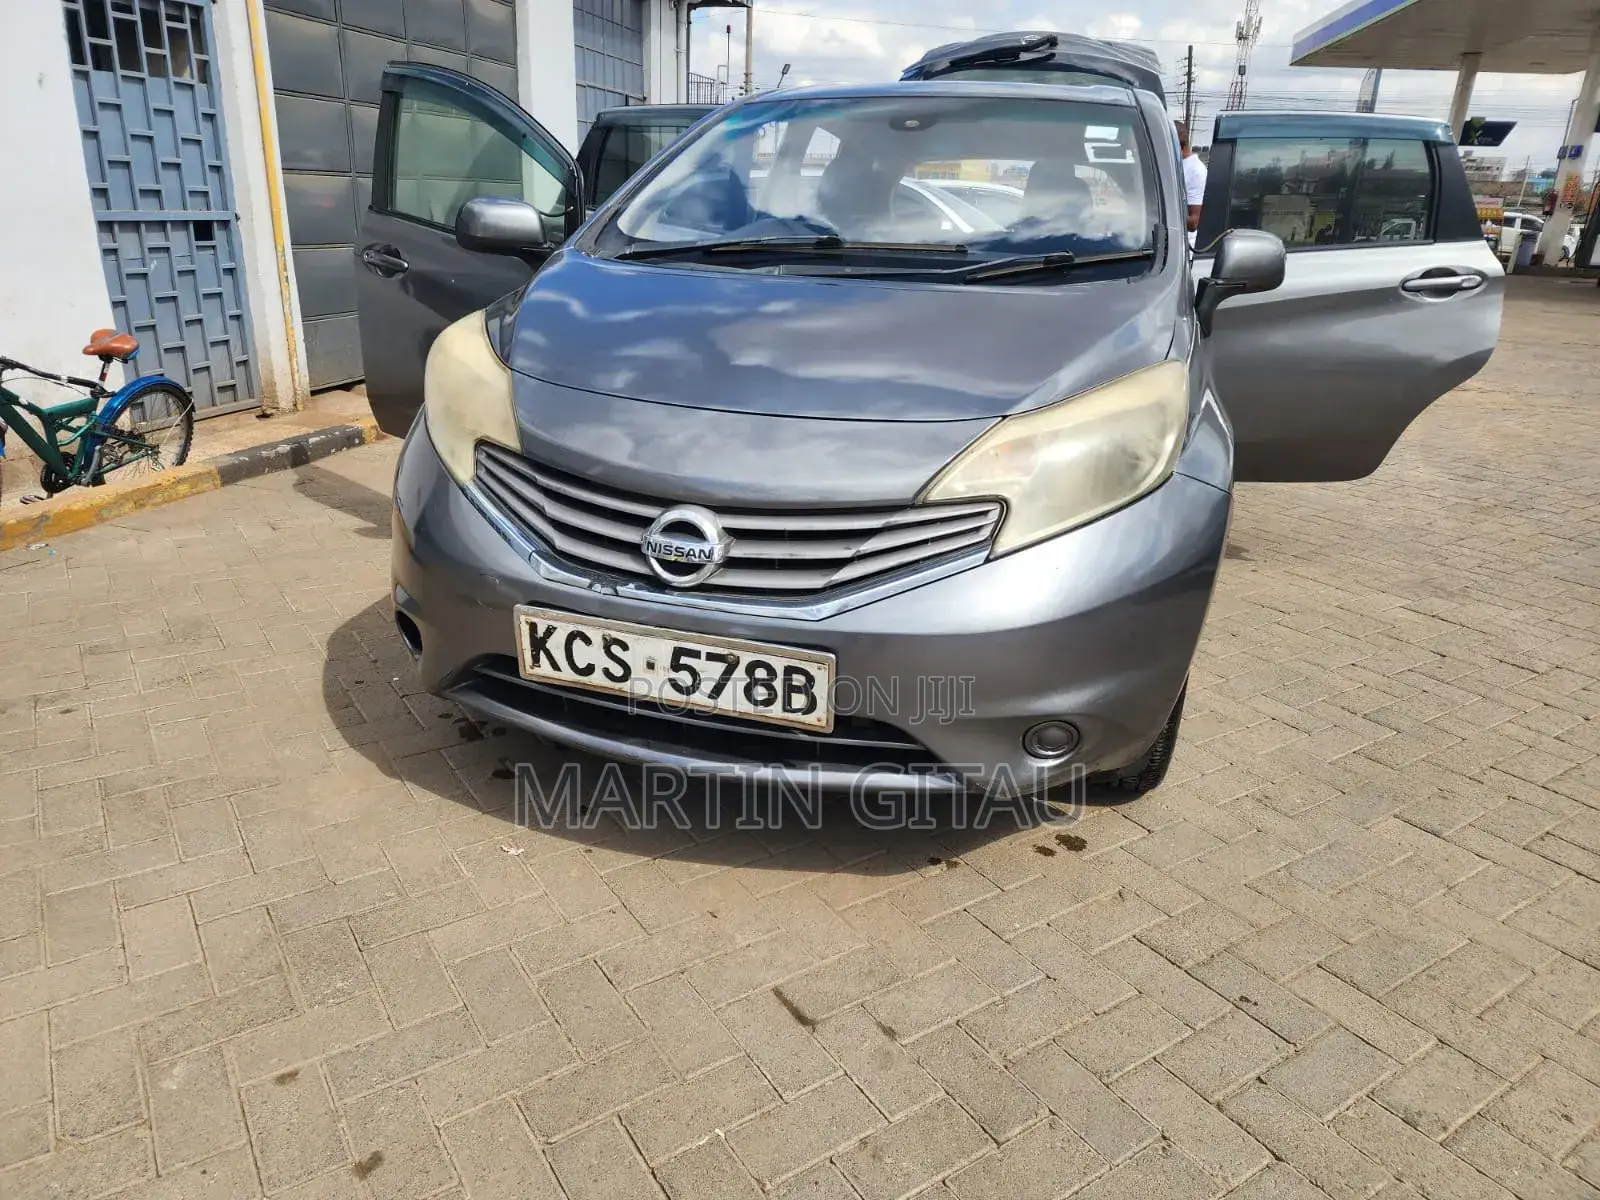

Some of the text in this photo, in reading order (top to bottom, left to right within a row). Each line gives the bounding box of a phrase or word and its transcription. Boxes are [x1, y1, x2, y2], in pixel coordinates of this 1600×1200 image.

[646, 540, 714, 561] NISSAN
[528, 621, 818, 716] KCS 578B
